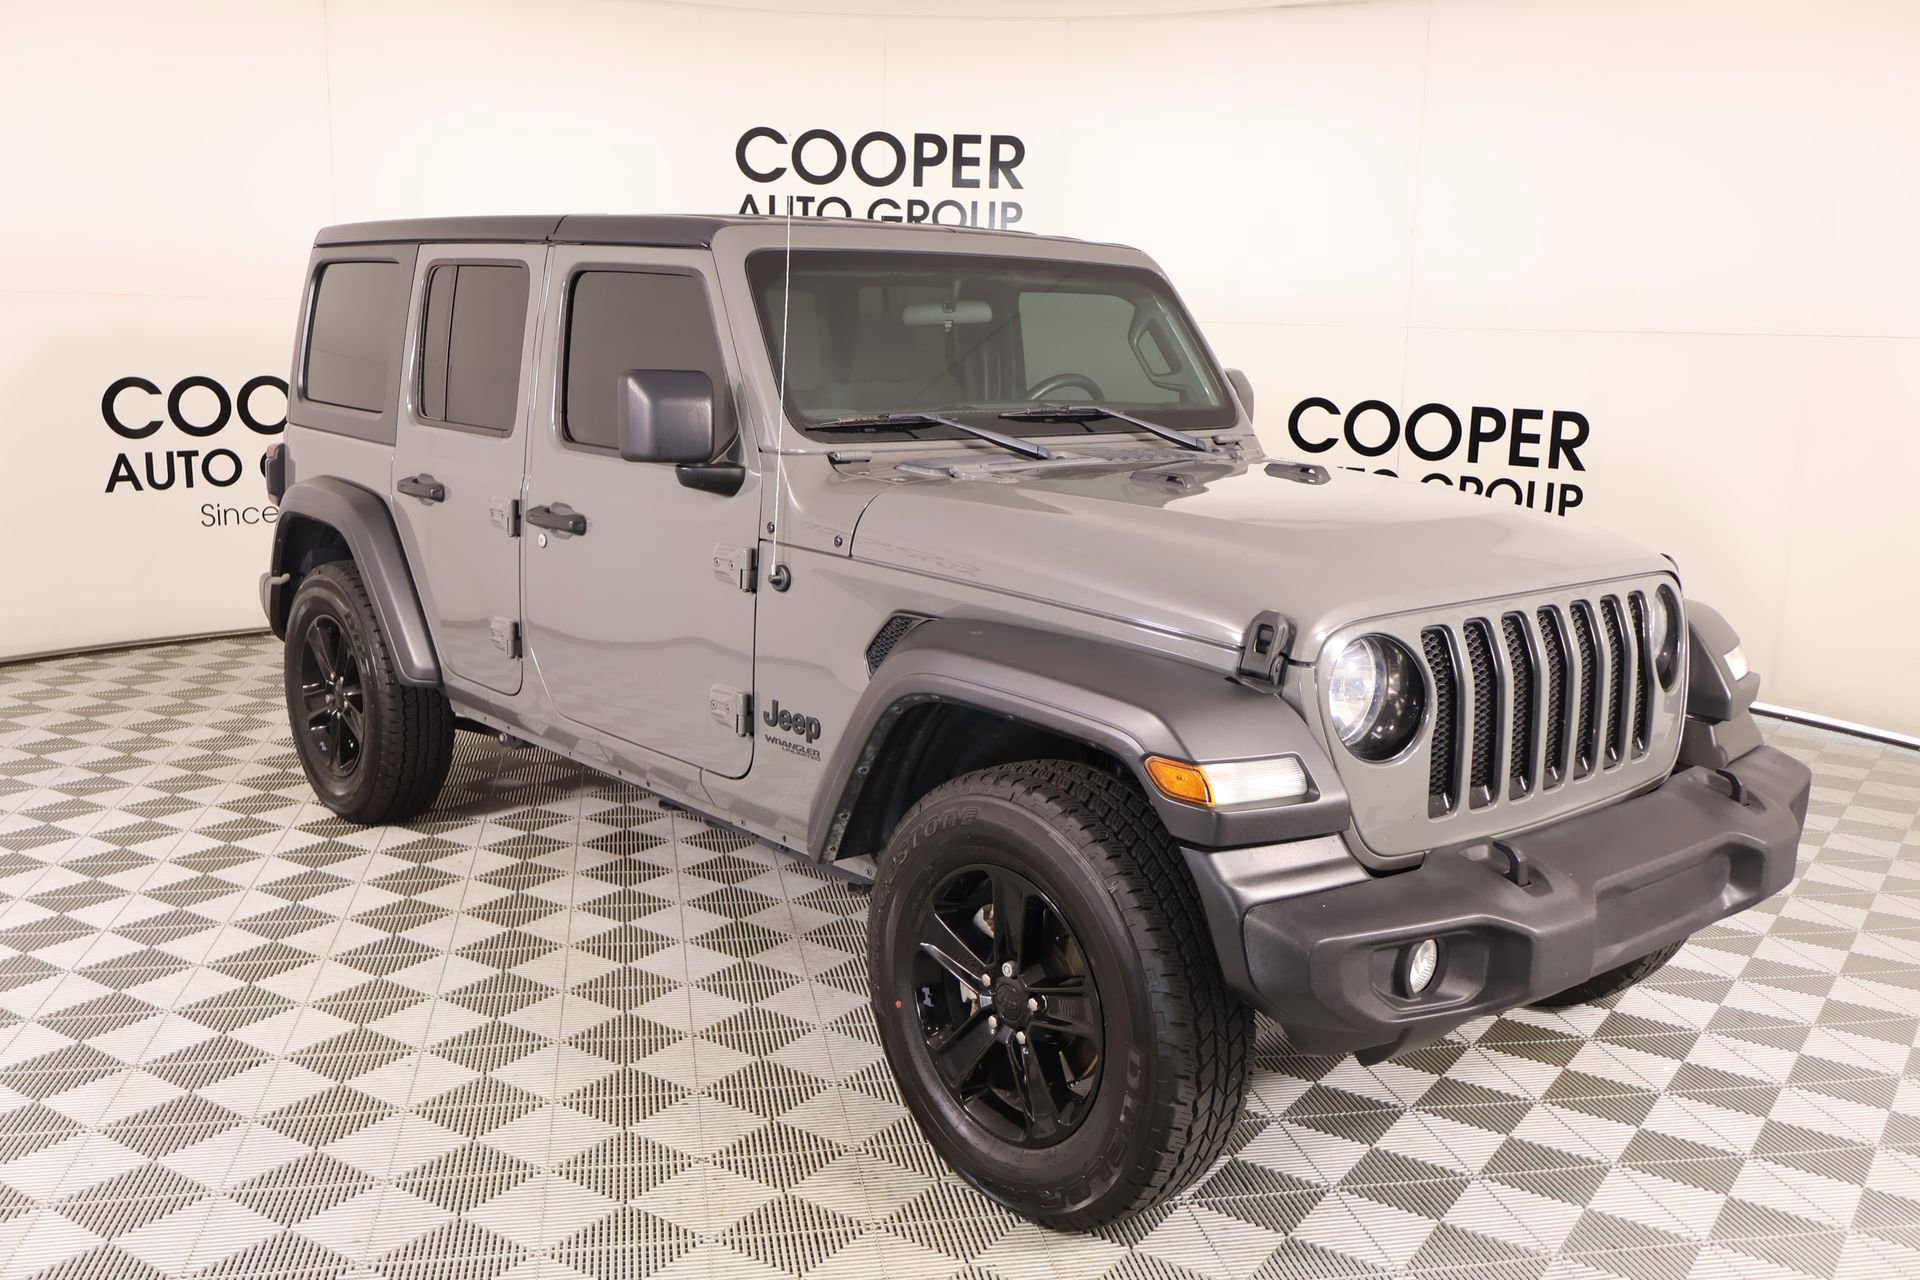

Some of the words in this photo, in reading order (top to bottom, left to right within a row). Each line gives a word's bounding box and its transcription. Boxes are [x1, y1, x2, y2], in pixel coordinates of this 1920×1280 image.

[735, 126, 1026, 190] COOPER
[867, 198, 1023, 231] GROUP
[1287, 396, 1590, 472] COOPER
[104, 448, 243, 494] AUTO
[200, 503, 280, 527] Since
[763, 698, 822, 744] Jeep
[765, 733, 821, 758] WRANGLER
